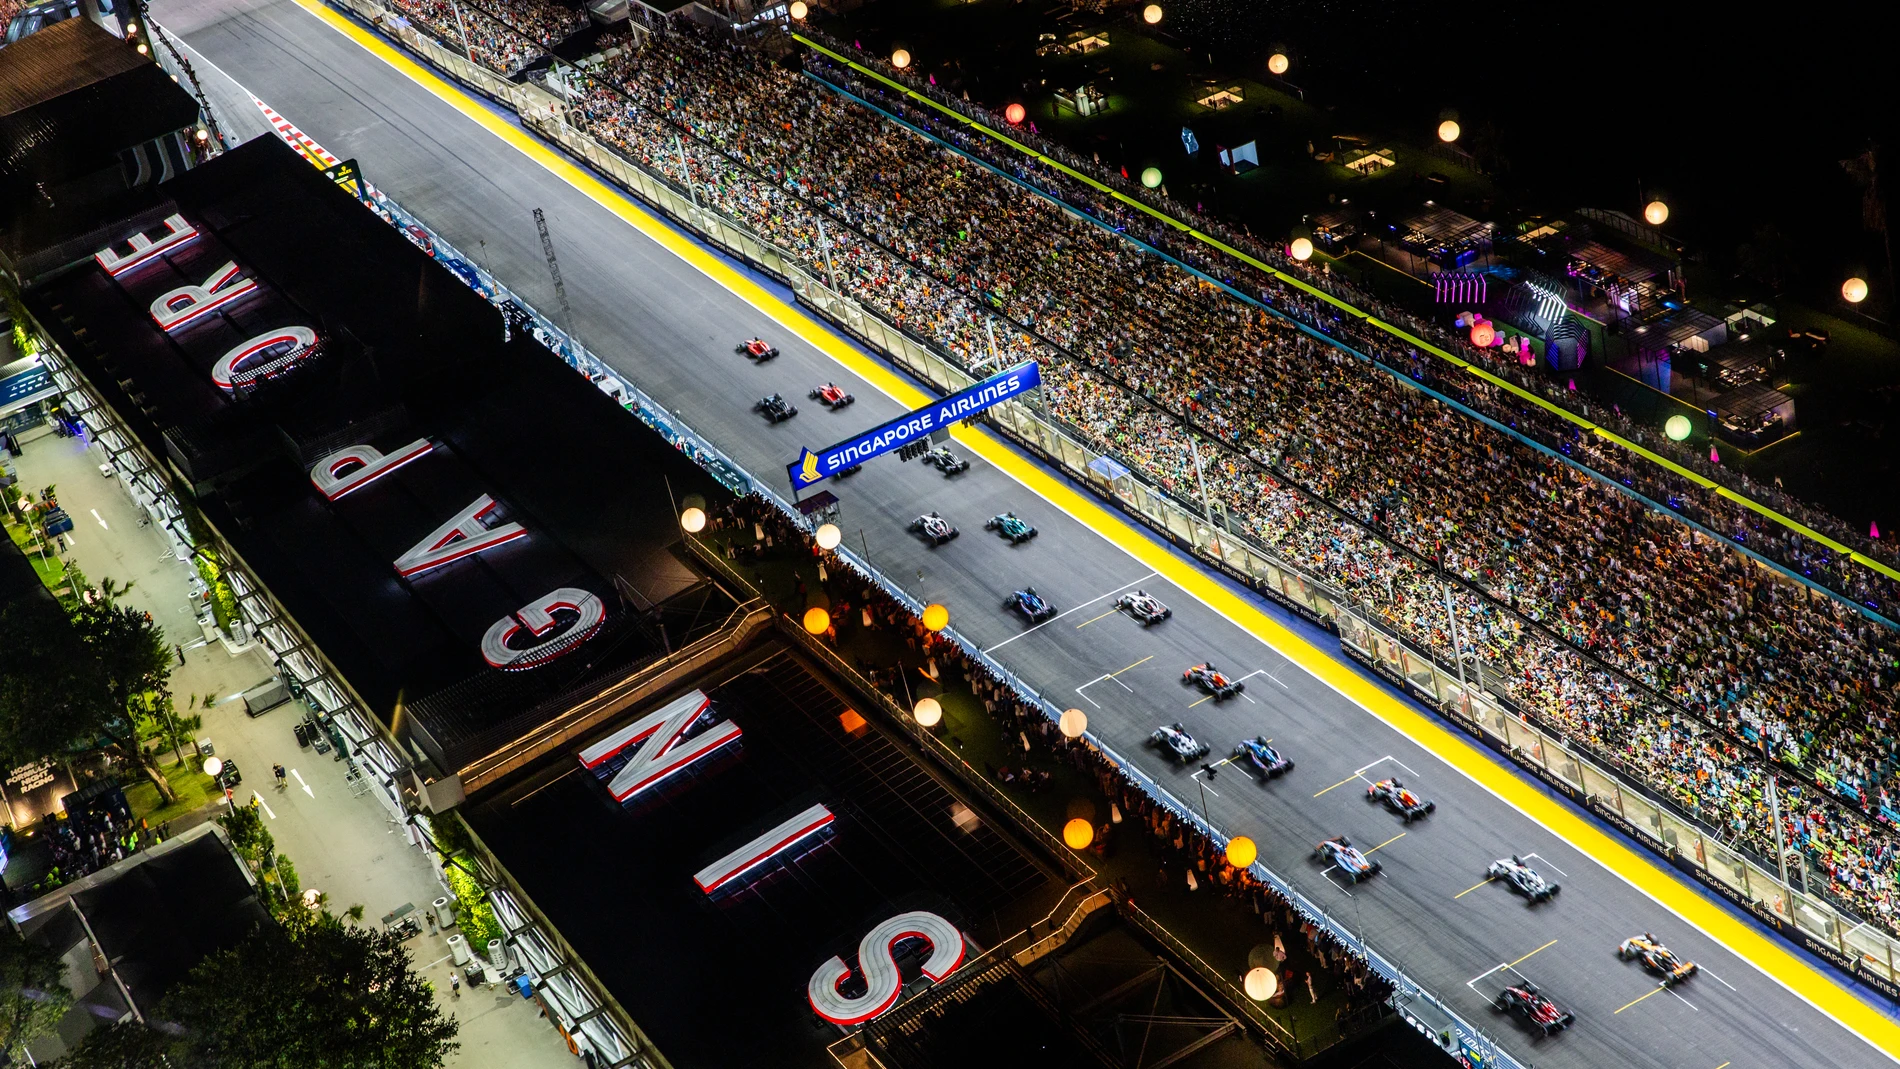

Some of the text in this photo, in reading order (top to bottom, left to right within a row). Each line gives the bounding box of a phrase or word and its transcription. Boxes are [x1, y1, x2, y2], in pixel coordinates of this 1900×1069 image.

[827, 375, 1020, 470] SINGAPORE AIRLINES
[1266, 589, 1299, 613] SINGAPORE
[1450, 711, 1478, 735] AIRLINES
[21, 773, 55, 794] RACING
[1539, 771, 1570, 794] AIRLINES
[1594, 804, 1635, 836] SINGAPORE
[1695, 869, 1739, 902] SINGAPORE
[1857, 969, 1898, 998] AIRLINES
